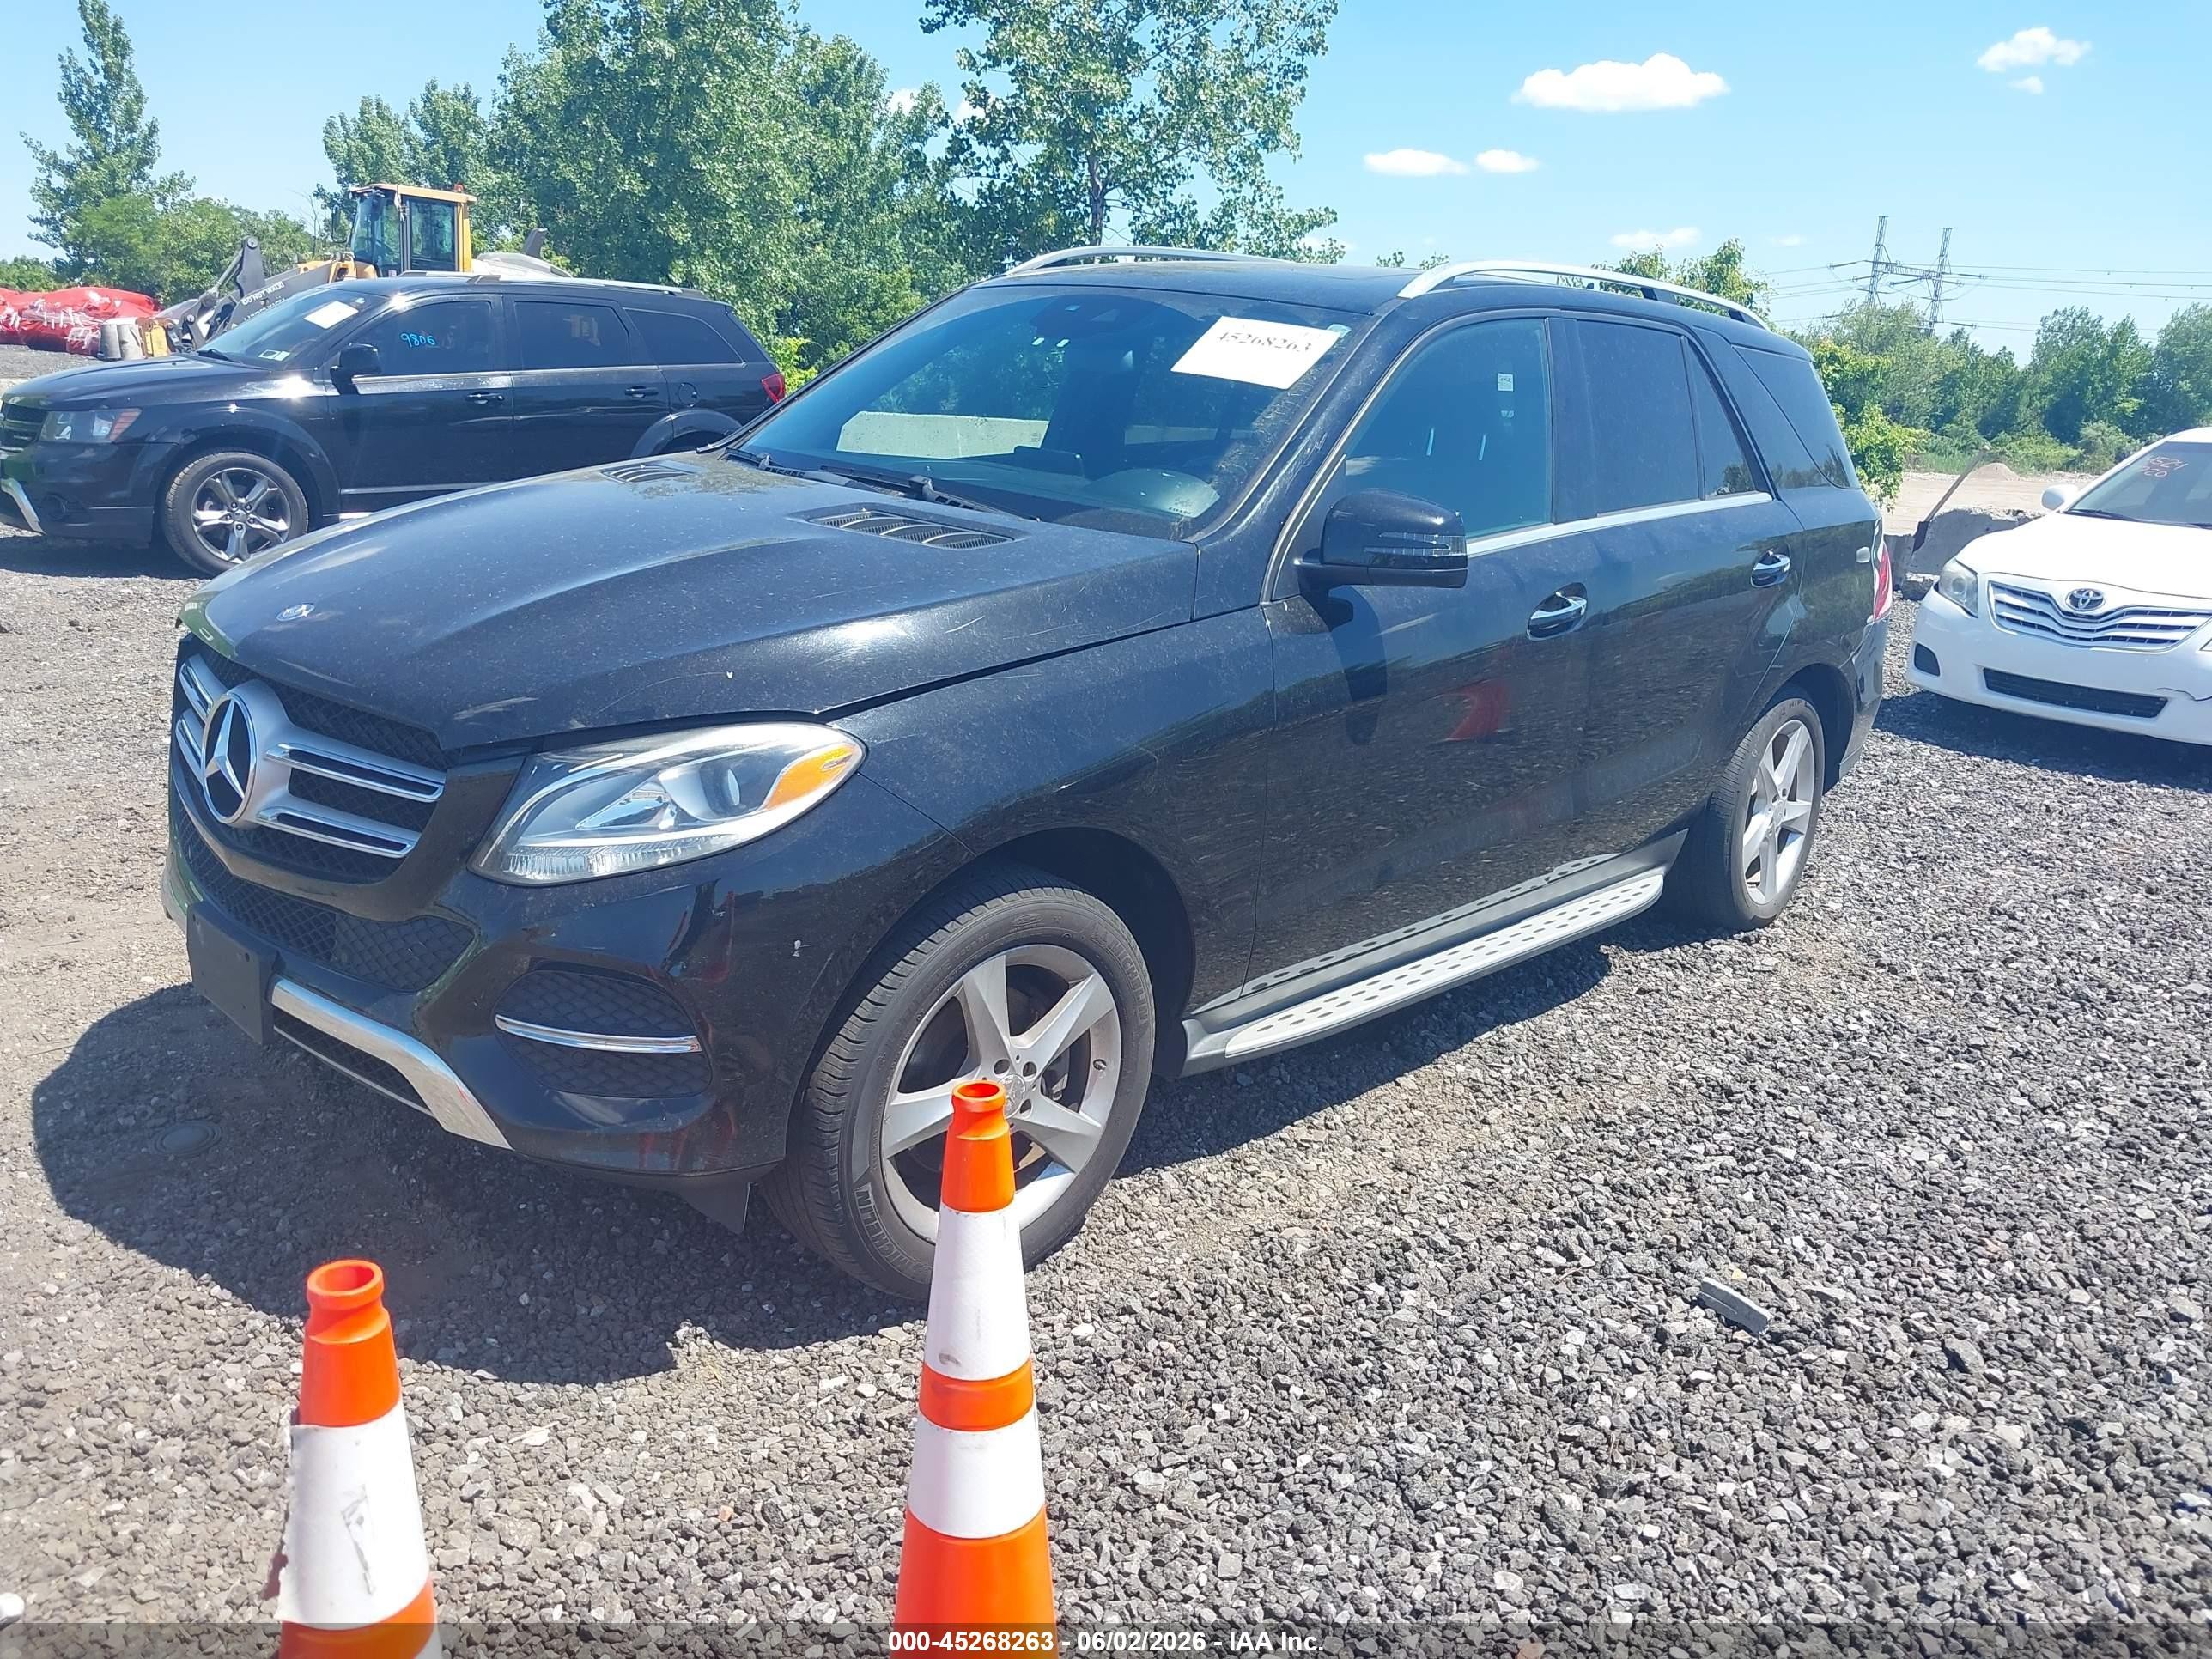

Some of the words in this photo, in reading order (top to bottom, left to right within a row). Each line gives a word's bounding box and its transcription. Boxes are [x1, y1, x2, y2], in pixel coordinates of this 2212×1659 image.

[400, 332, 436, 349] 9806
[1217, 331, 1312, 352] 45268263
[1107, 939, 1149, 1023] MICHELIN
